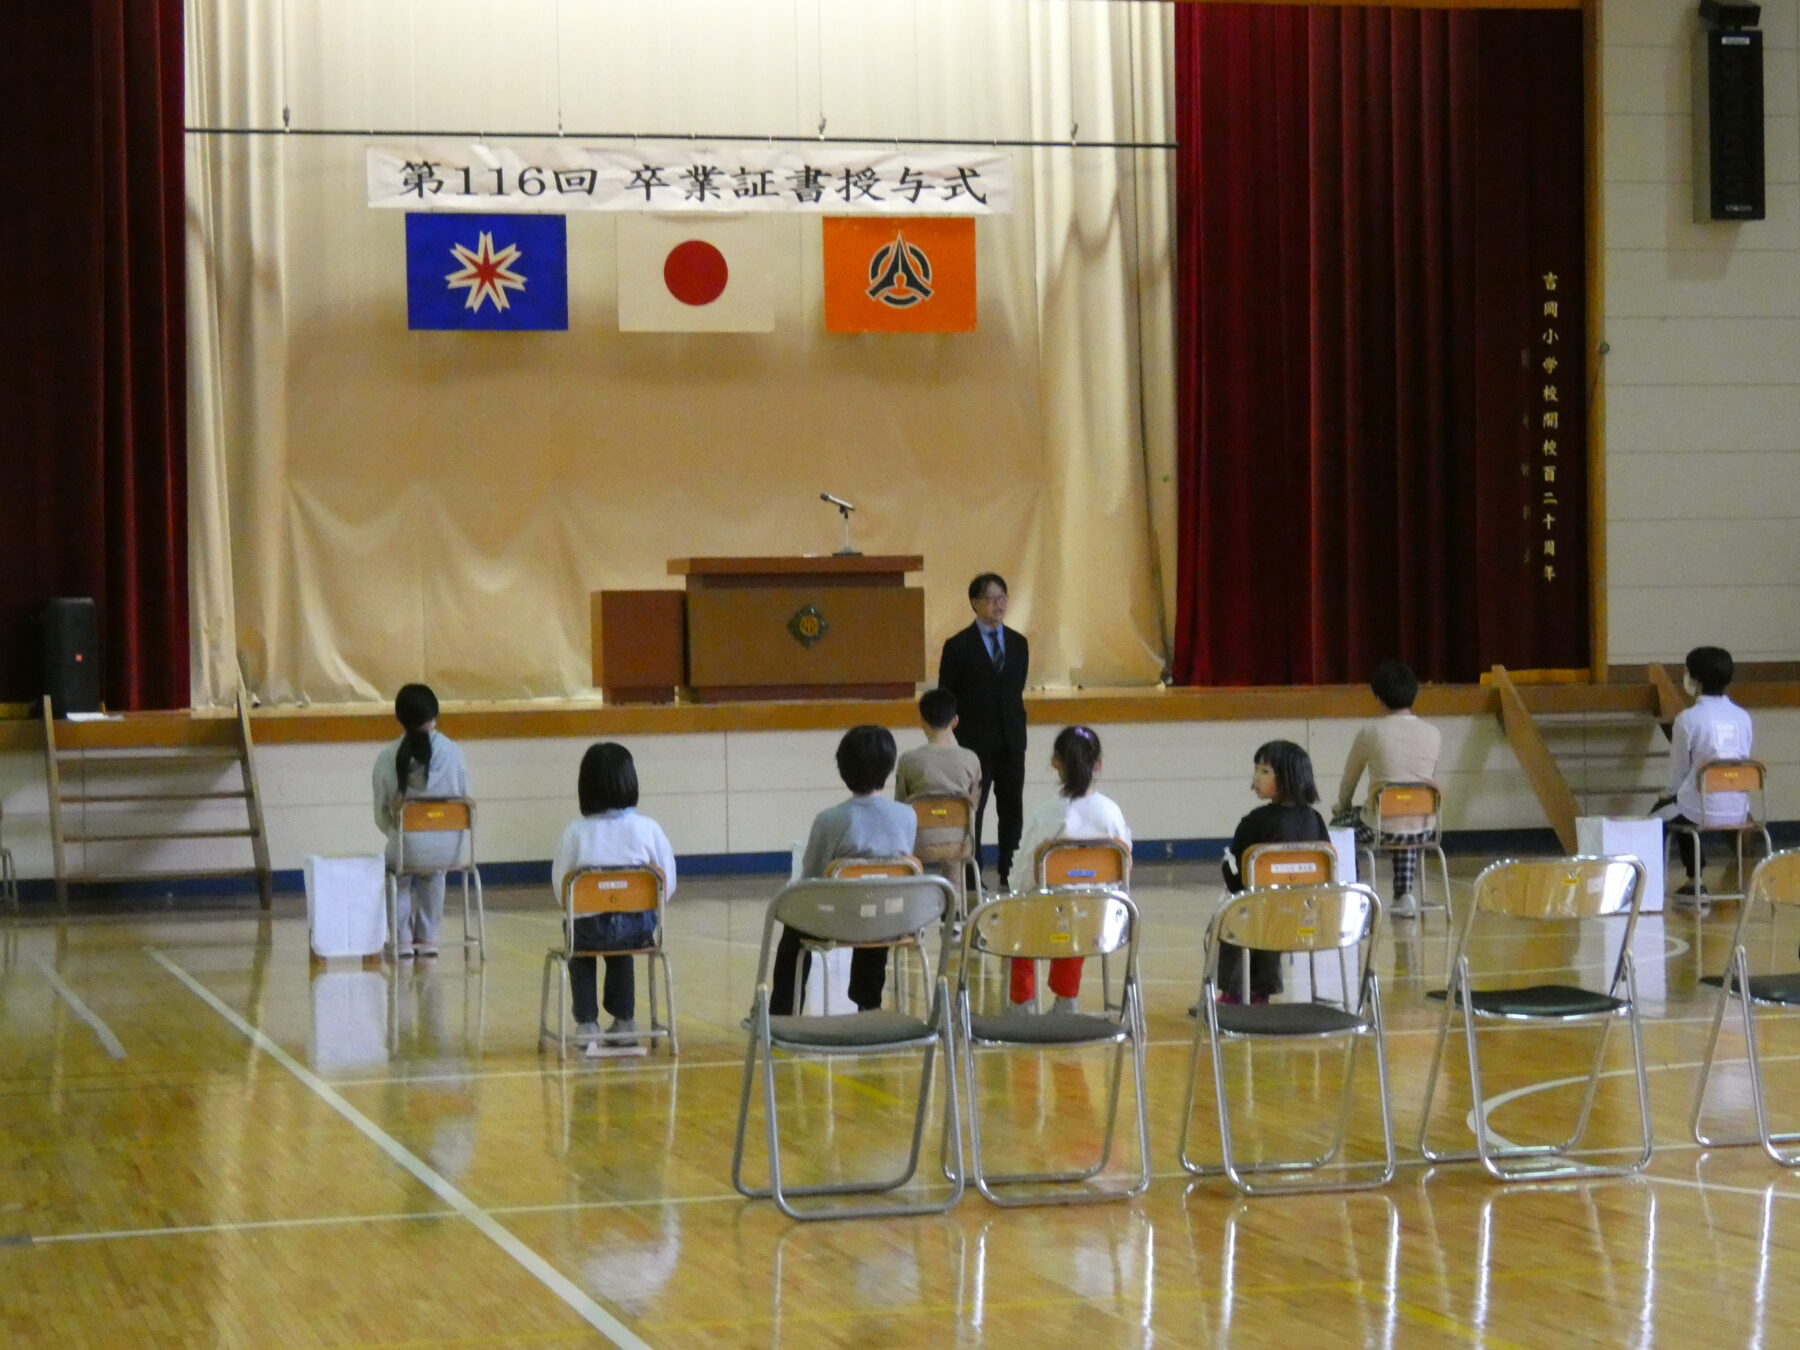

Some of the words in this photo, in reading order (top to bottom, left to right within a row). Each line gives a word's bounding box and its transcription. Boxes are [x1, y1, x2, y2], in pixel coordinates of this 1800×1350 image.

[400, 160, 598, 199] 第116回
[624, 163, 987, 205] 卒業証書授与式
